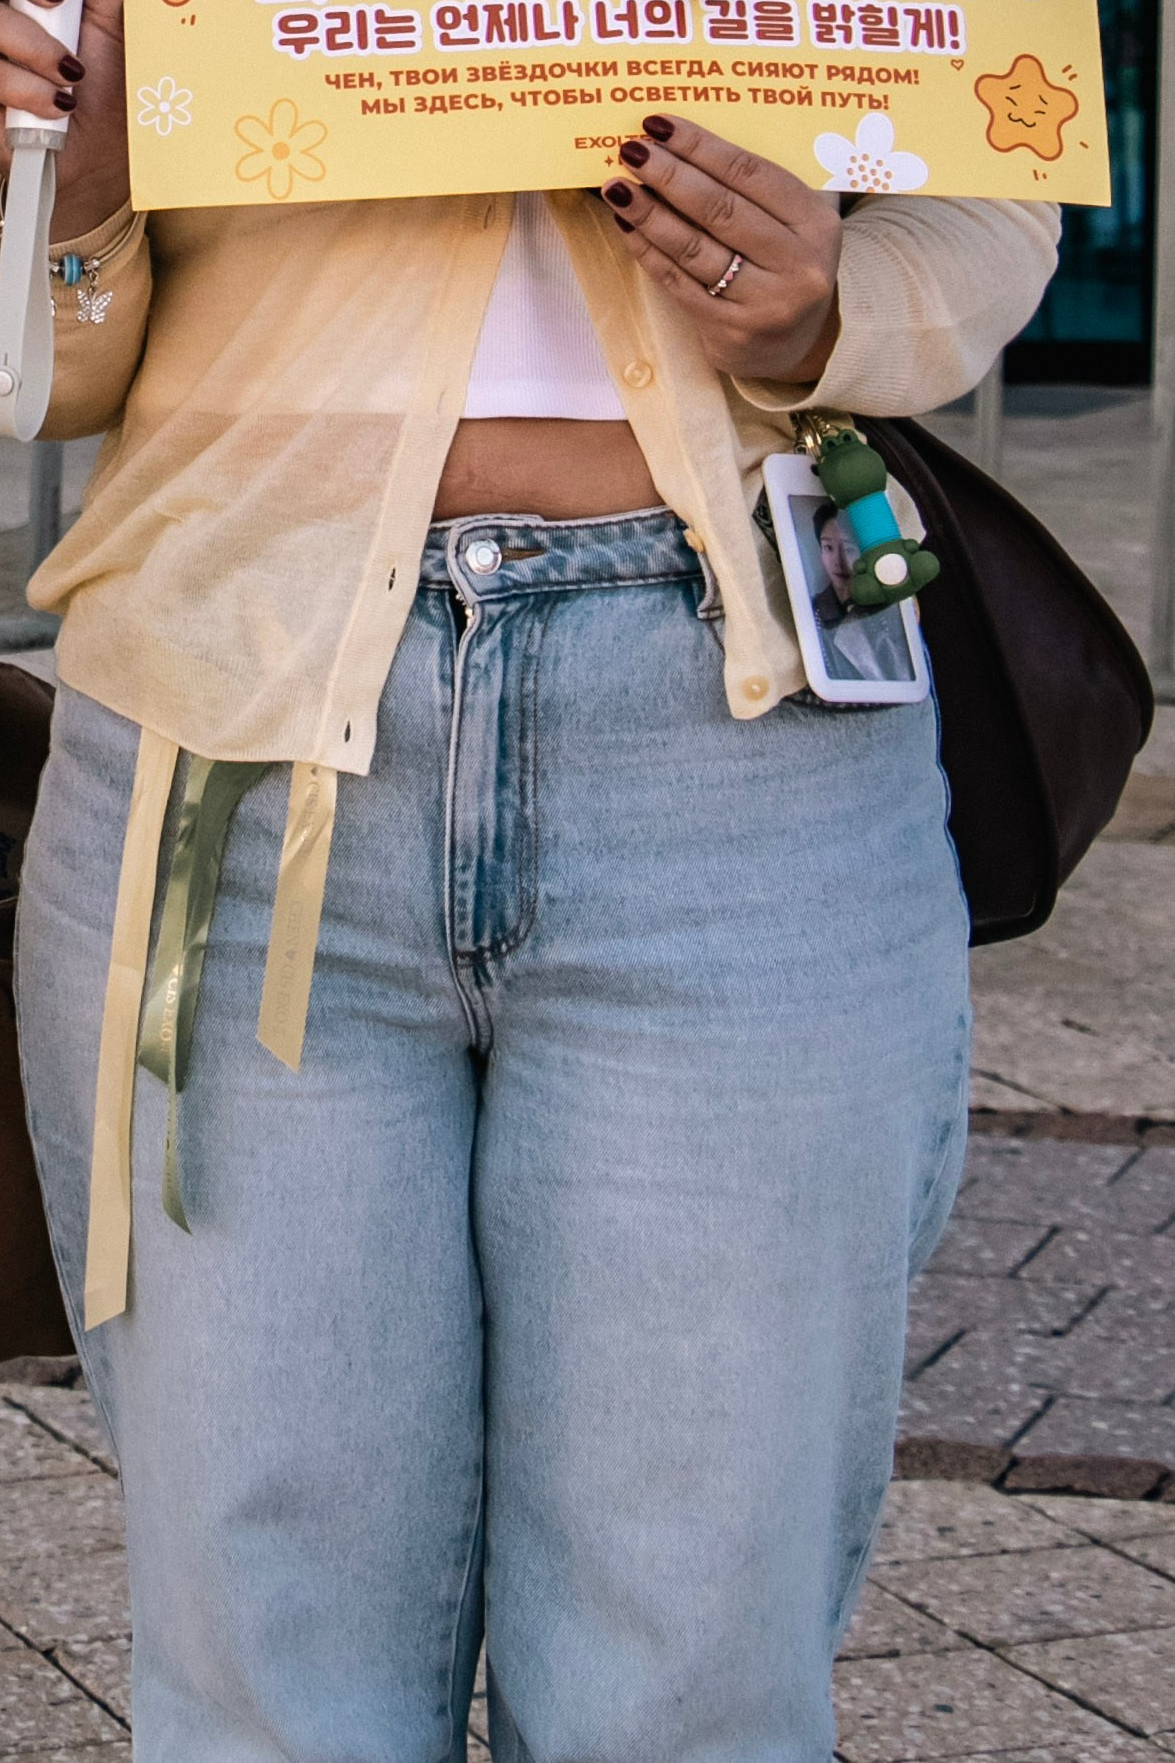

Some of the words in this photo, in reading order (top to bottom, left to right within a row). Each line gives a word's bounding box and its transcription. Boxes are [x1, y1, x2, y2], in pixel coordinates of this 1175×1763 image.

[275, 8, 422, 56] 우리는
[433, 0, 581, 48] 언제나
[810, 1, 961, 51] 밝힐게!
[323, 71, 384, 92] ЧЕН,
[389, 66, 460, 88] ТВОИ
[465, 58, 620, 86] ЗВЁЗДОЧКИ
[625, 58, 724, 80] ВСЕГДА
[730, 60, 820, 82] СИЯЮТ
[825, 63, 921, 86] РЯДОМ!
[359, 97, 407, 117] МЫ
[412, 92, 505, 115] ЗДЕСЬ,
[509, 86, 603, 109] ЧТОБЫ
[608, 85, 742, 105] ОСВЕТИТЬ
[748, 84, 815, 108] ТВОЙ
[819, 90, 891, 111] ПУТЬ!
